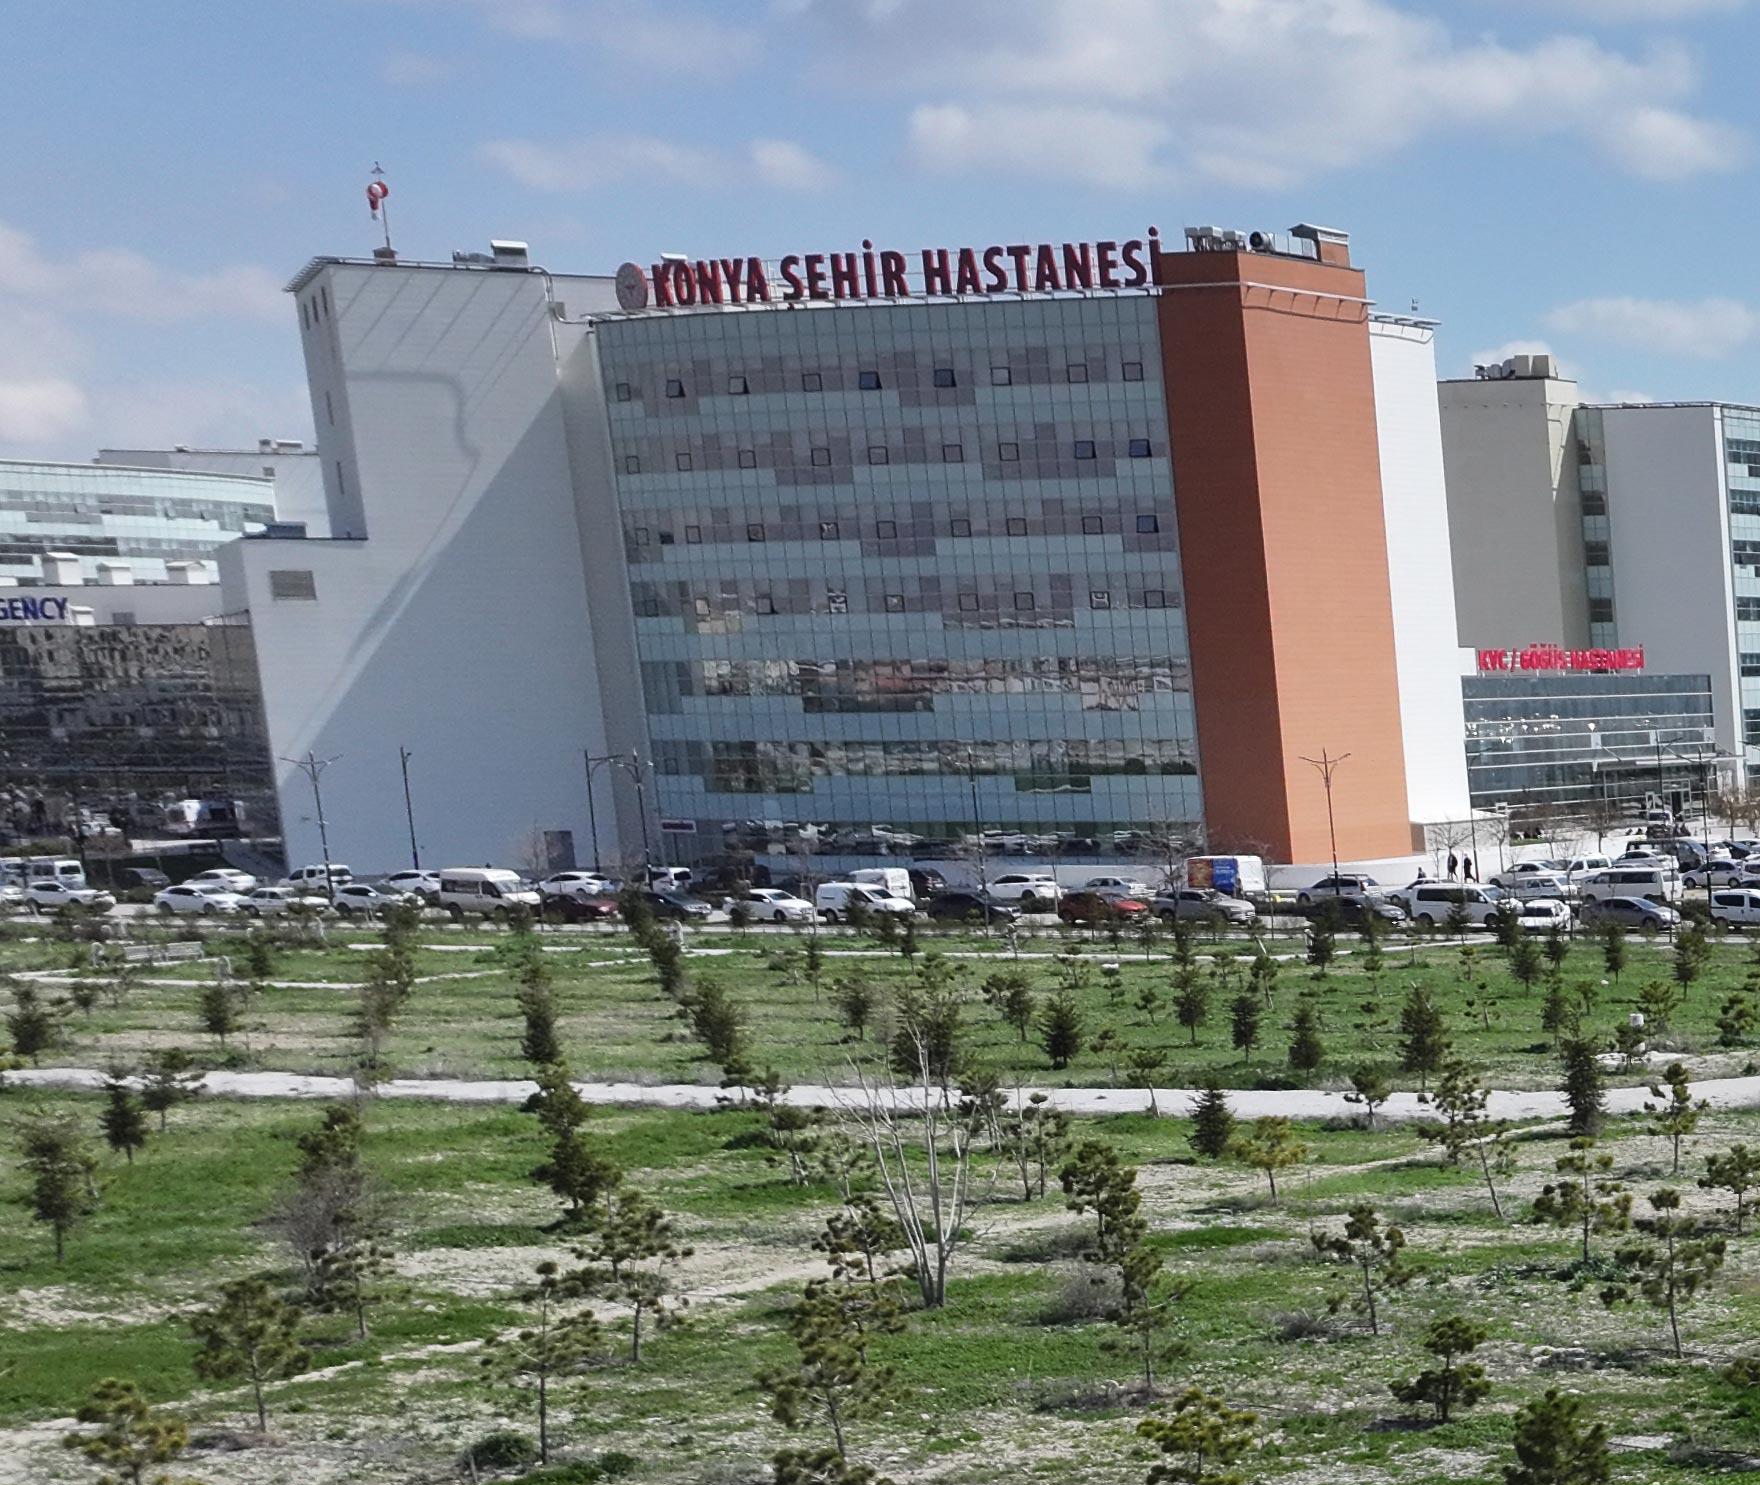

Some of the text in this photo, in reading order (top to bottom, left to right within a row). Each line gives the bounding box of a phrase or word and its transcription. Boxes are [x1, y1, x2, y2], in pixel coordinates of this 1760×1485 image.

[652, 226, 1162, 309] KONYA ŞEHİR HASTANESİ
